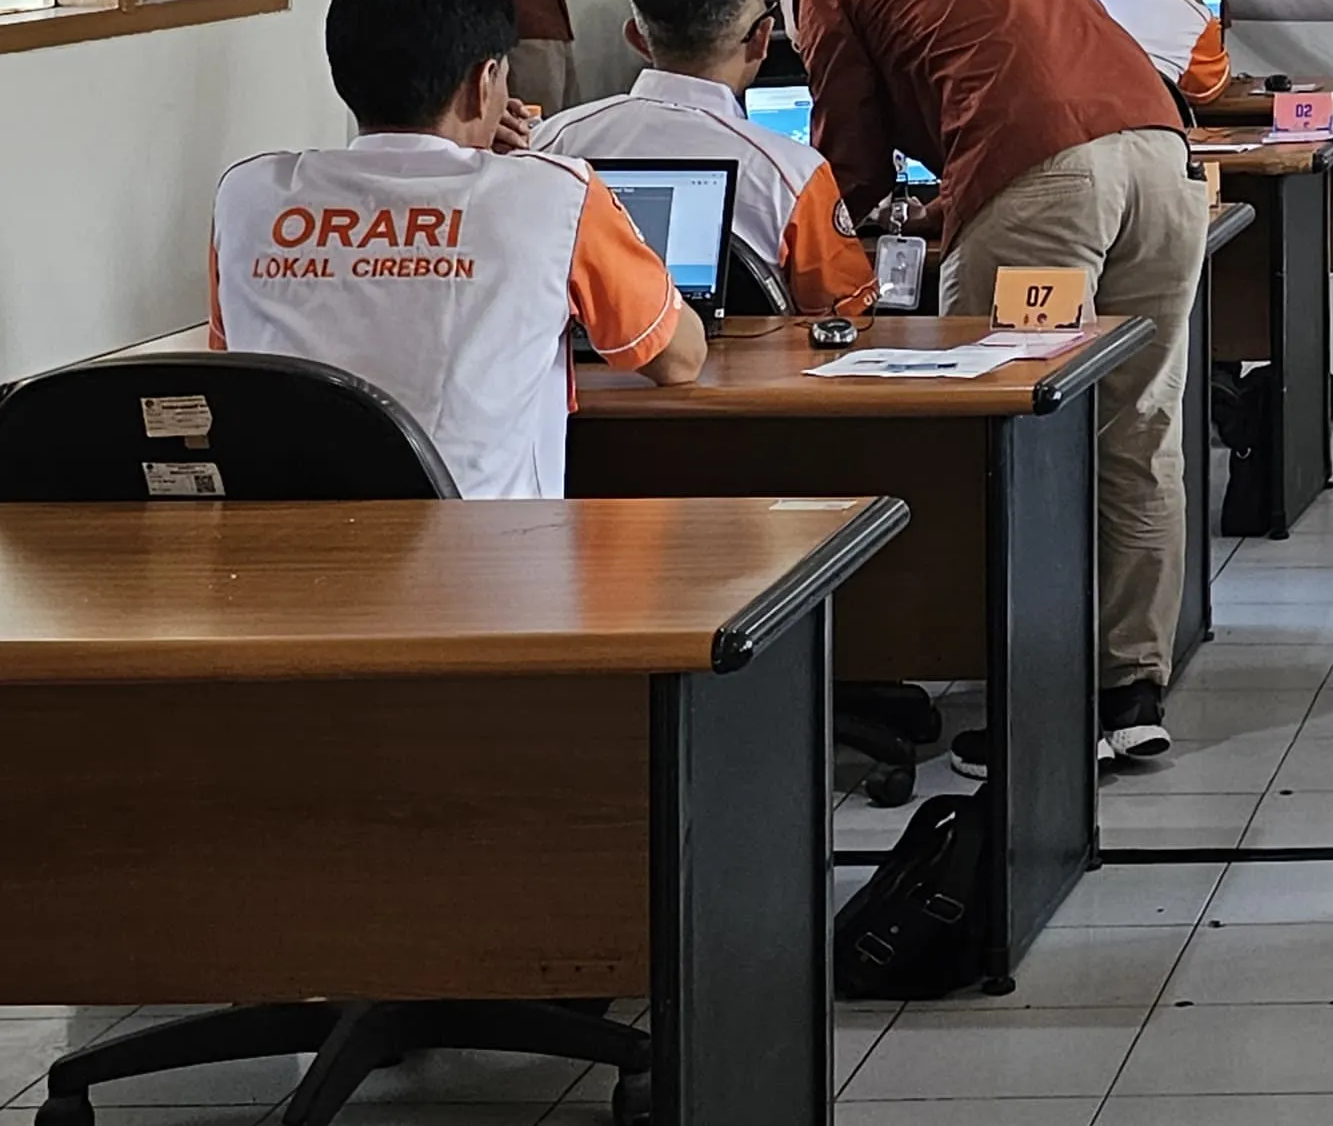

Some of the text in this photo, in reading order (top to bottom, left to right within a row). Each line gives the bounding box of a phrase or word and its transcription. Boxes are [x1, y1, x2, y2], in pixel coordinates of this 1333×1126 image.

[1295, 103, 1313, 118] 02
[271, 207, 463, 248] ORARI
[251, 257, 474, 279] LOKAL CIREBON
[1026, 285, 1054, 308] 07
